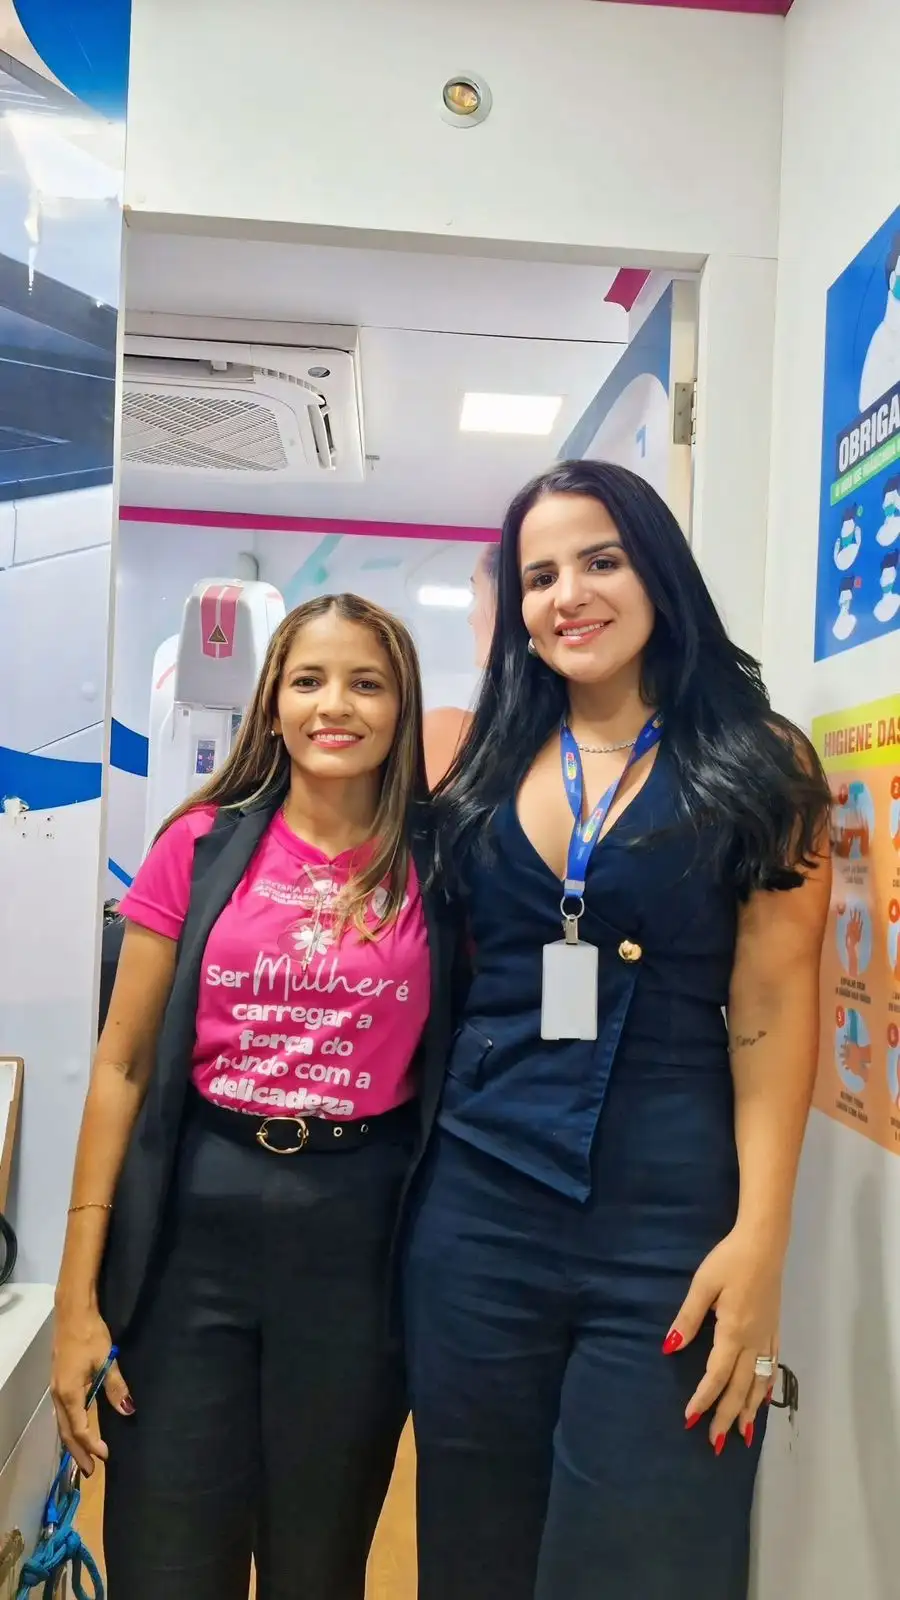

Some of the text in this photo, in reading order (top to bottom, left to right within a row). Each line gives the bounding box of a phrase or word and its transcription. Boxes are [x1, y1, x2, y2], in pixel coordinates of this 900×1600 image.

[824, 722, 872, 757] HIGIENE
[206, 950, 410, 1002] Ser Mulher é
[231, 1003, 373, 1030] carregar a
[238, 1029, 354, 1056] força do
[294, 1062, 351, 1087] com
[355, 1071, 372, 1089] a
[208, 1073, 355, 1116] delicadeza
